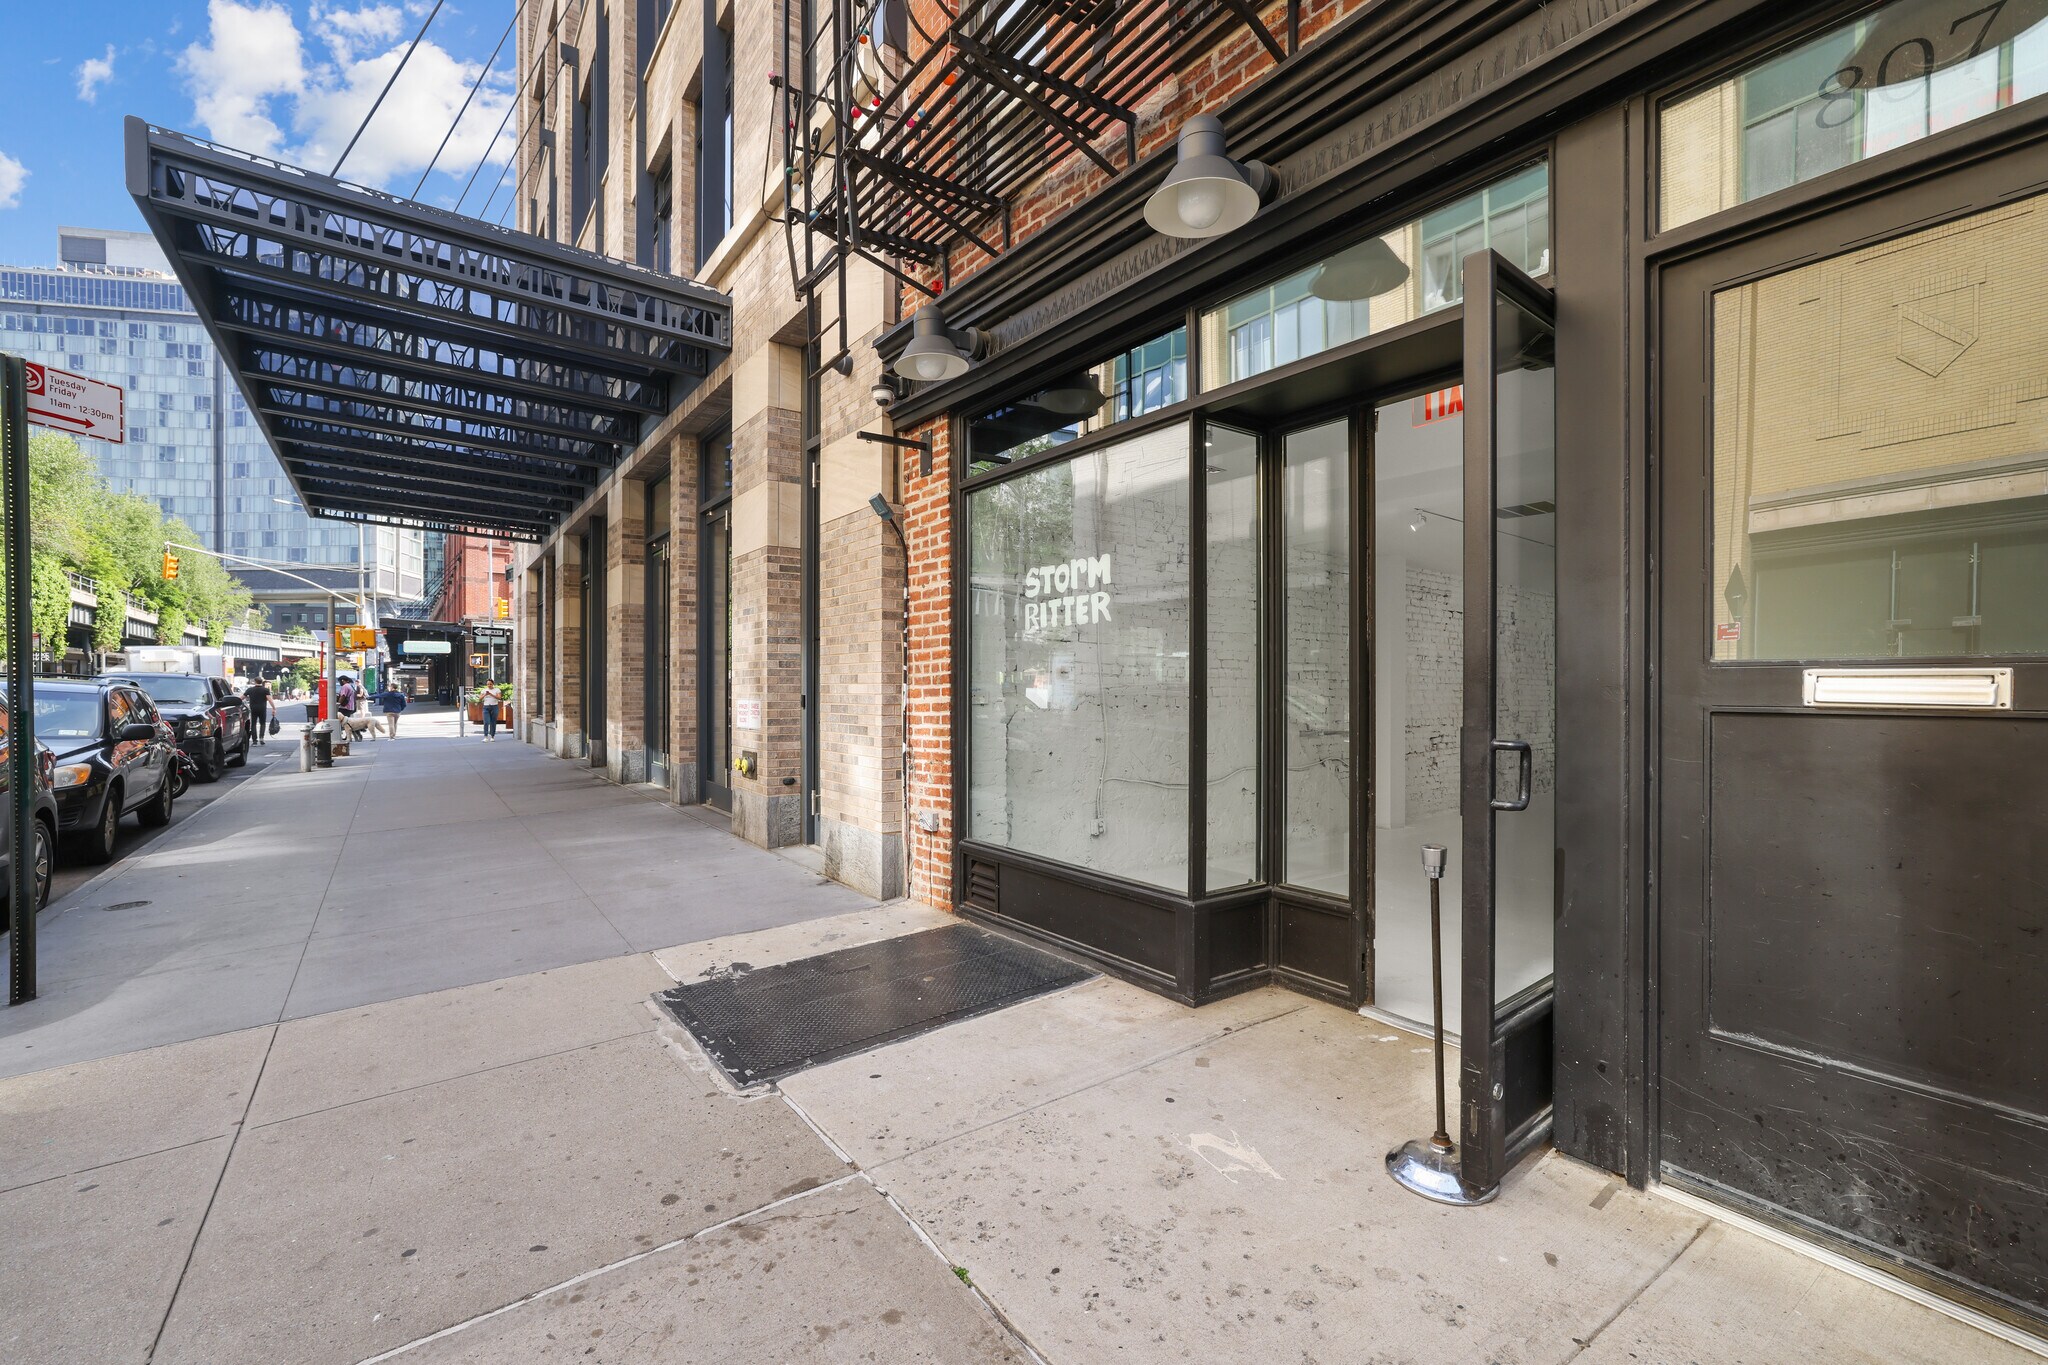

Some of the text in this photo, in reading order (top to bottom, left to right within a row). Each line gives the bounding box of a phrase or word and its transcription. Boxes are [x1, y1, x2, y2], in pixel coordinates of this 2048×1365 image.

[1814, 0, 2008, 129] 807
[49, 375, 86, 393] Tuesday
[49, 385, 77, 399] Friday
[50, 398, 71, 410] 11am
[79, 405, 114, 420] 12:30pm
[1024, 591, 1112, 634] RITTER
